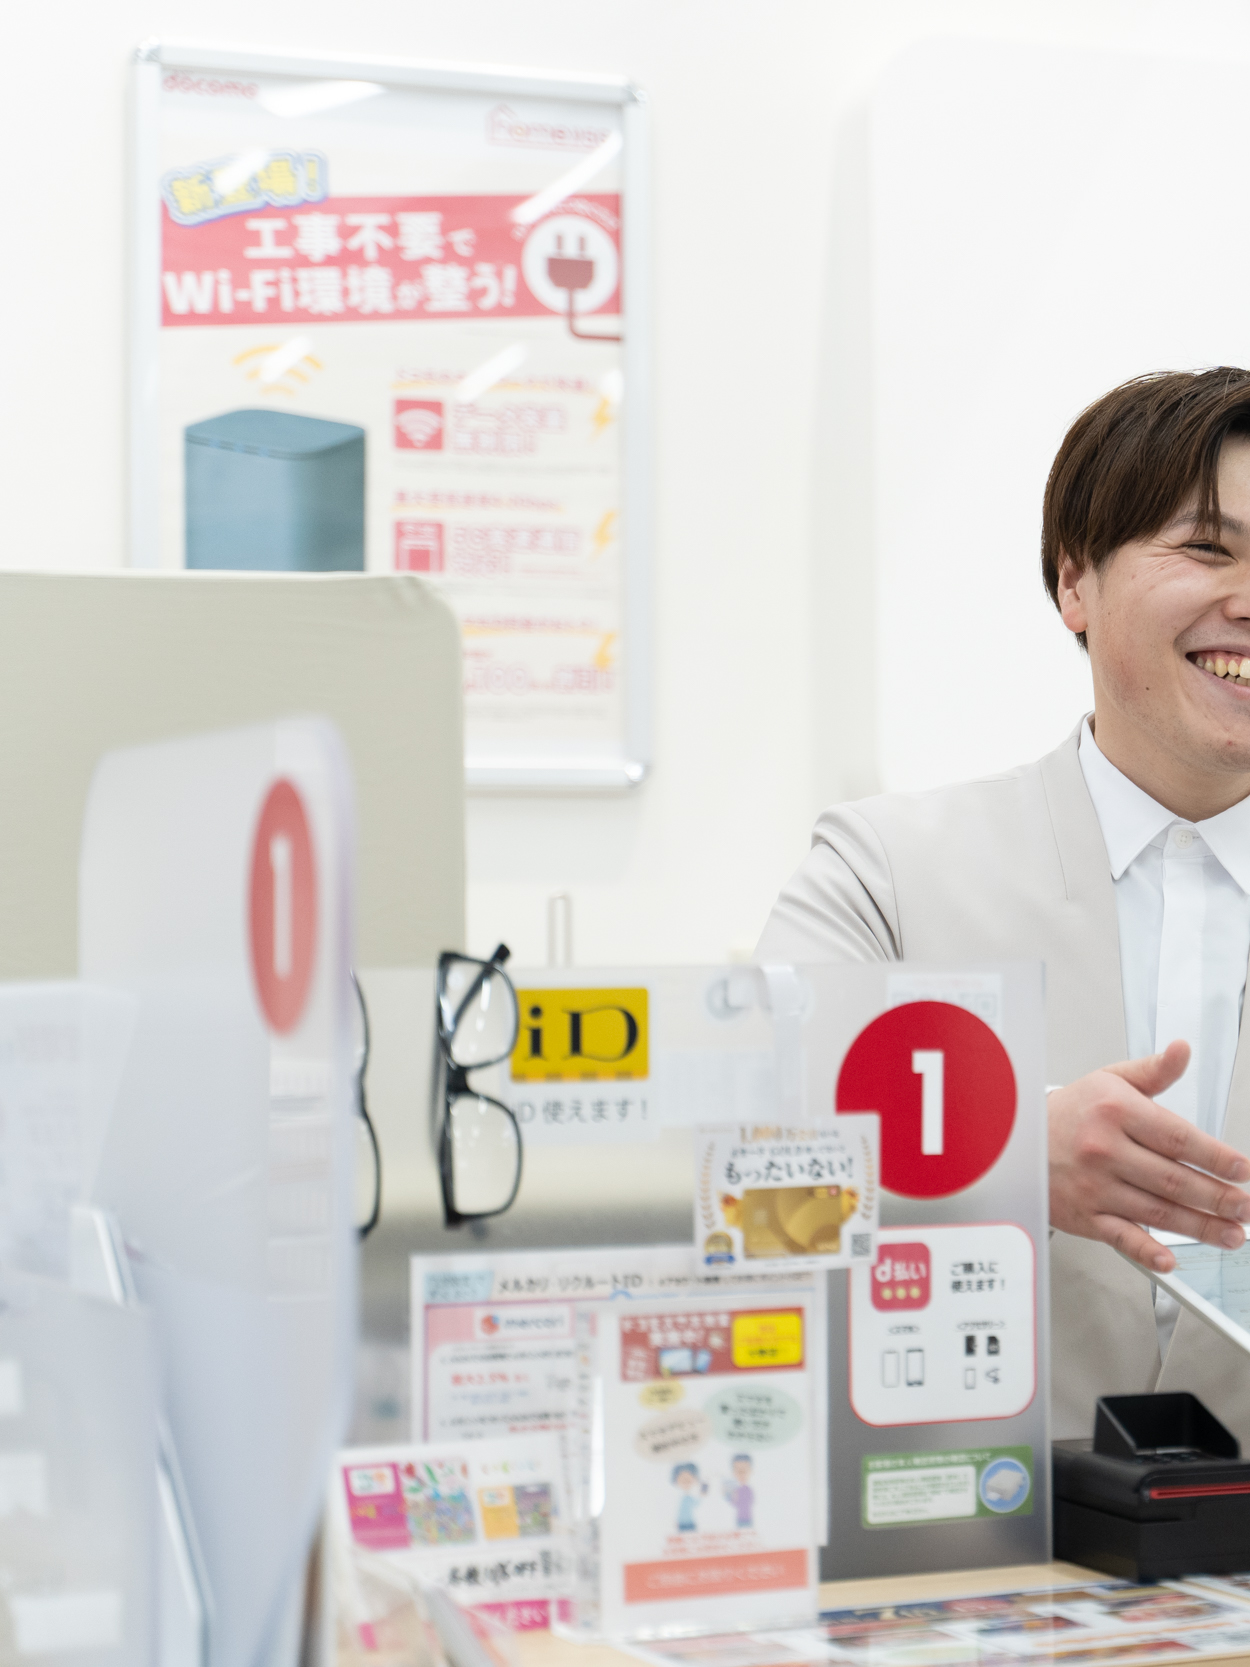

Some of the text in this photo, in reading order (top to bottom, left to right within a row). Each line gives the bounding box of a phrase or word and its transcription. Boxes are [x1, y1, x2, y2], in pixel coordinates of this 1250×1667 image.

[244, 211, 476, 262] 工事不要で
[162, 264, 518, 316] Wi-Fi環境が整う!
[268, 833, 294, 982] 1
[525, 1005, 639, 1062] iD
[911, 1049, 944, 1156] 1
[723, 1157, 854, 1185] もったいない!
[874, 1257, 999, 1283] d払い ご購入に
[950, 1278, 1005, 1294] 使えます!
